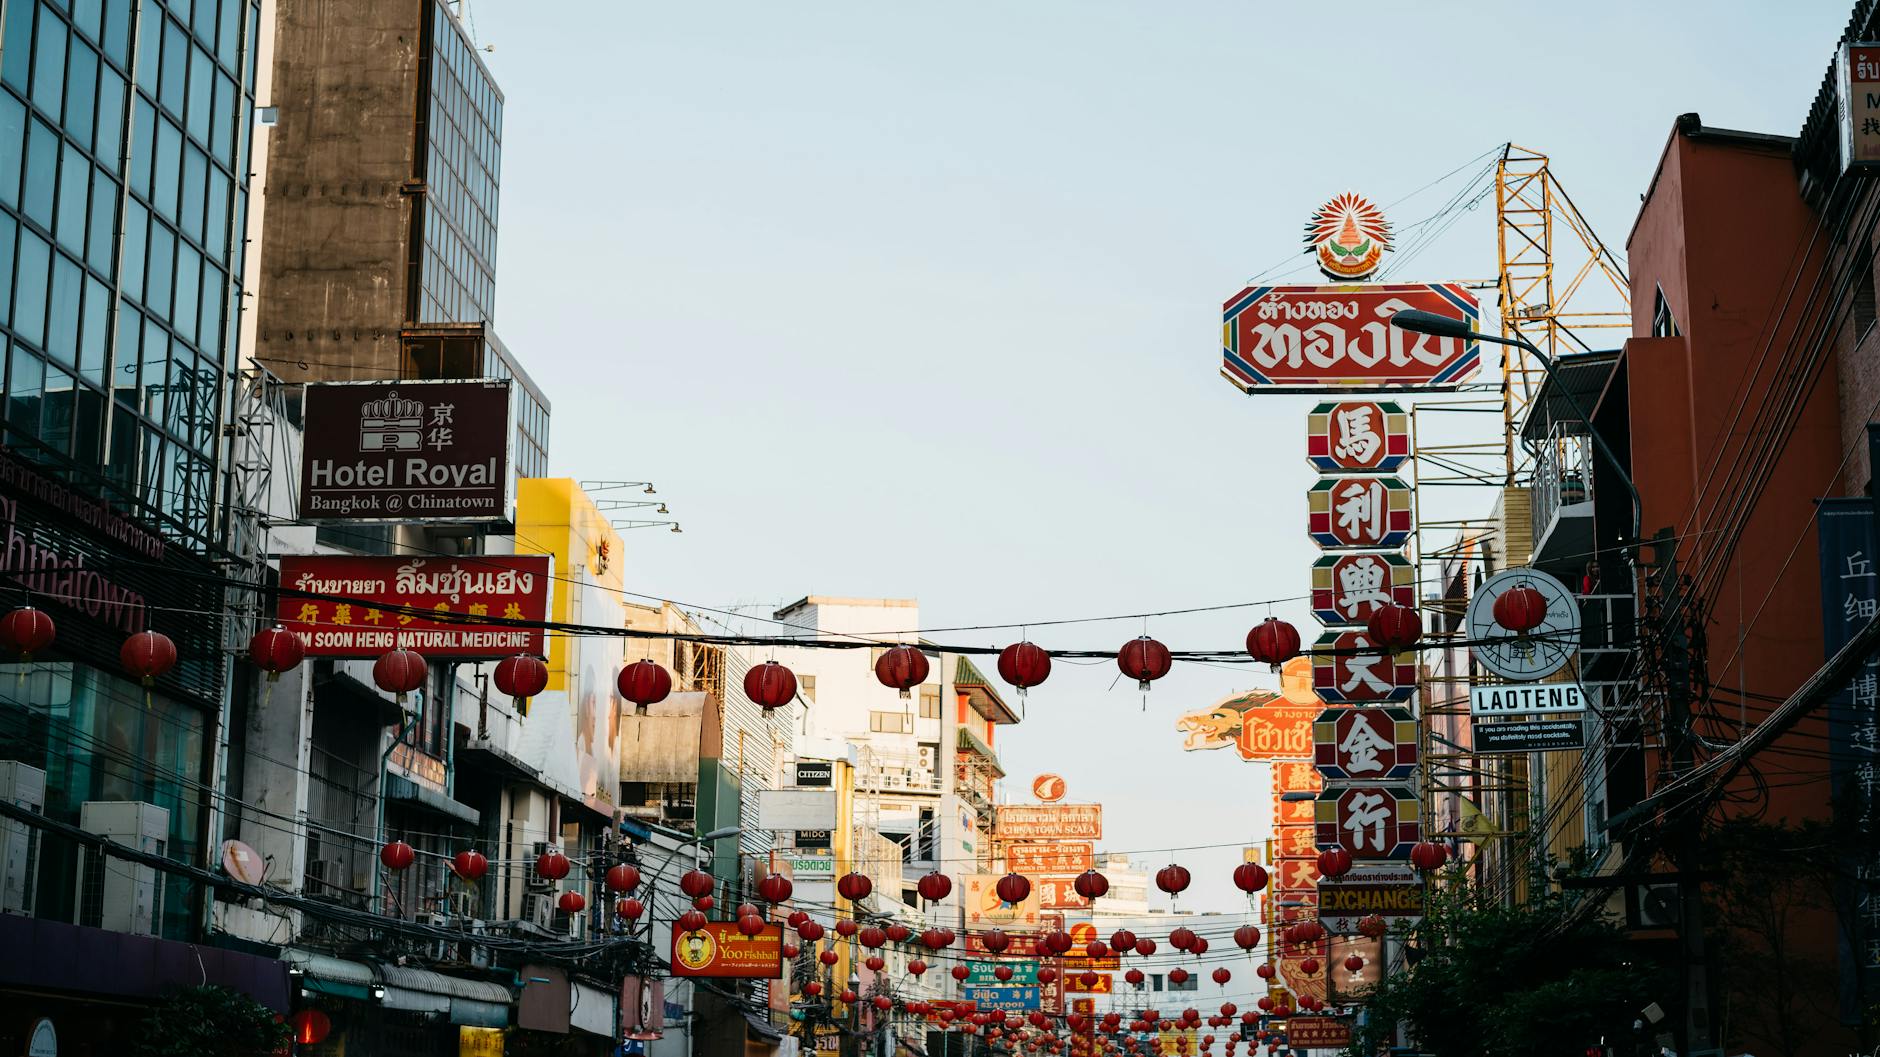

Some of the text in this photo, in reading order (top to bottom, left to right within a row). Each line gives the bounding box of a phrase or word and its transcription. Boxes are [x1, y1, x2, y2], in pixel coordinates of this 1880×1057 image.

[1257, 293, 1359, 320] ห้างทอง
[427, 402, 456, 452] 京华
[311, 457, 497, 487] Hotel Royal
[310, 494, 495, 514] Bangkok @ Chinatown
[315, 632, 354, 648] SOON
[356, 632, 394, 647] HENG
[397, 632, 460, 648] NATURAL
[461, 631, 531, 647] MEDICINE
[1478, 687, 1579, 711] LAOTENG
[1484, 726, 1496, 734] you
[797, 769, 831, 779] CITIZEN
[800, 830, 826, 838] MIDO
[1064, 825, 1096, 834] SCALA
[1320, 889, 1422, 911] EXCHANGE
[719, 945, 778, 960] Yoo Fishball
